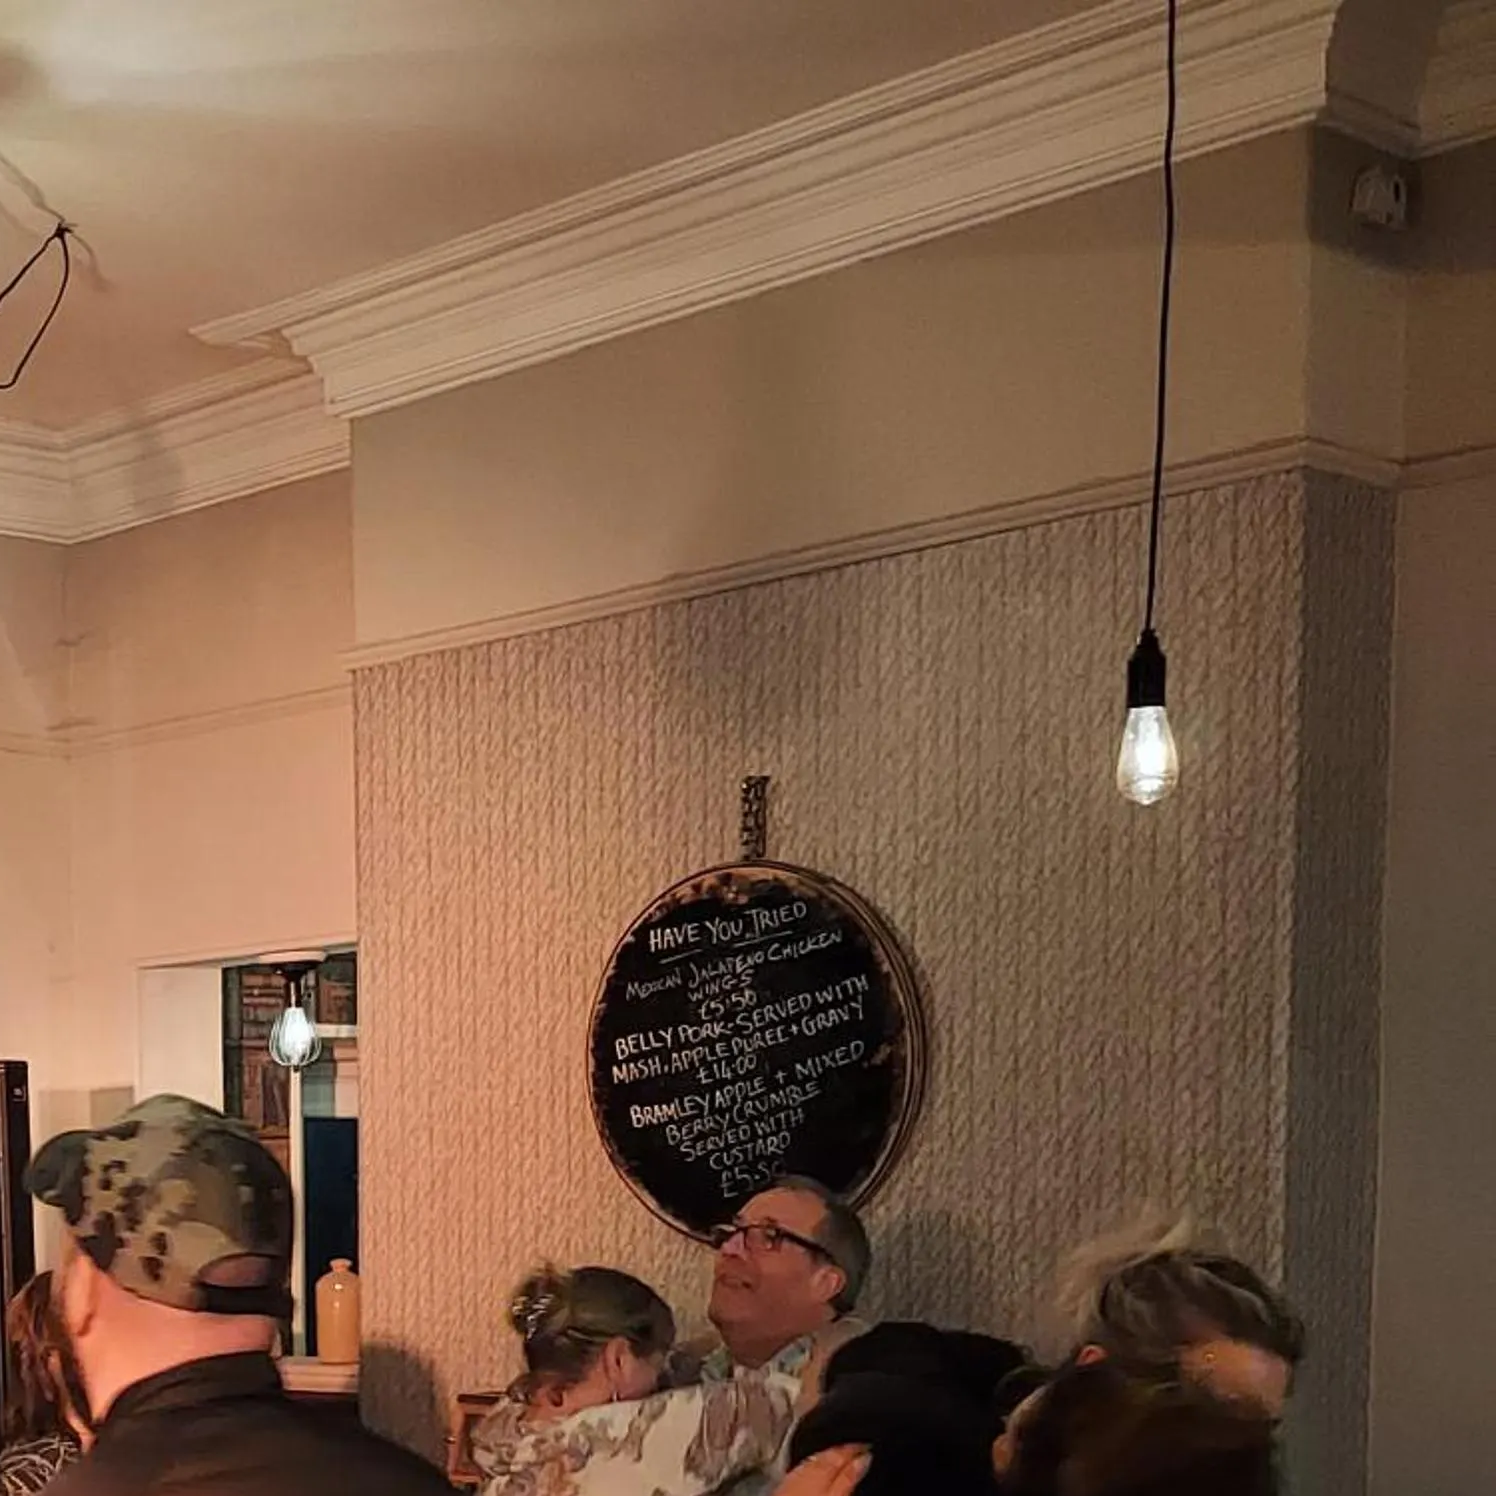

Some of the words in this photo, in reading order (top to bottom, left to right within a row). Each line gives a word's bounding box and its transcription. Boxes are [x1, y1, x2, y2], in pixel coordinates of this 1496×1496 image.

[649, 923, 700, 952] HAVE
[705, 916, 743, 945] YOU
[744, 901, 807, 938] TRIED
[768, 930, 842, 962] CHICKEN
[688, 971, 755, 1002] WINGS
[615, 1029, 673, 1060] BELLY
[815, 975, 870, 1004] WITH
[671, 1042, 732, 1075] APPLE
[801, 998, 865, 1036] GRAVY
[630, 1094, 713, 1128] BRAMLEY
[714, 1076, 768, 1109] APPLE
[795, 1041, 865, 1079] MIXED
[665, 1114, 732, 1146] BERRY
[732, 1082, 823, 1124] CRUMBLE
[679, 1126, 752, 1162] SERVED
[754, 1107, 805, 1137] WITH
[709, 1132, 791, 1171] CUSTARD
